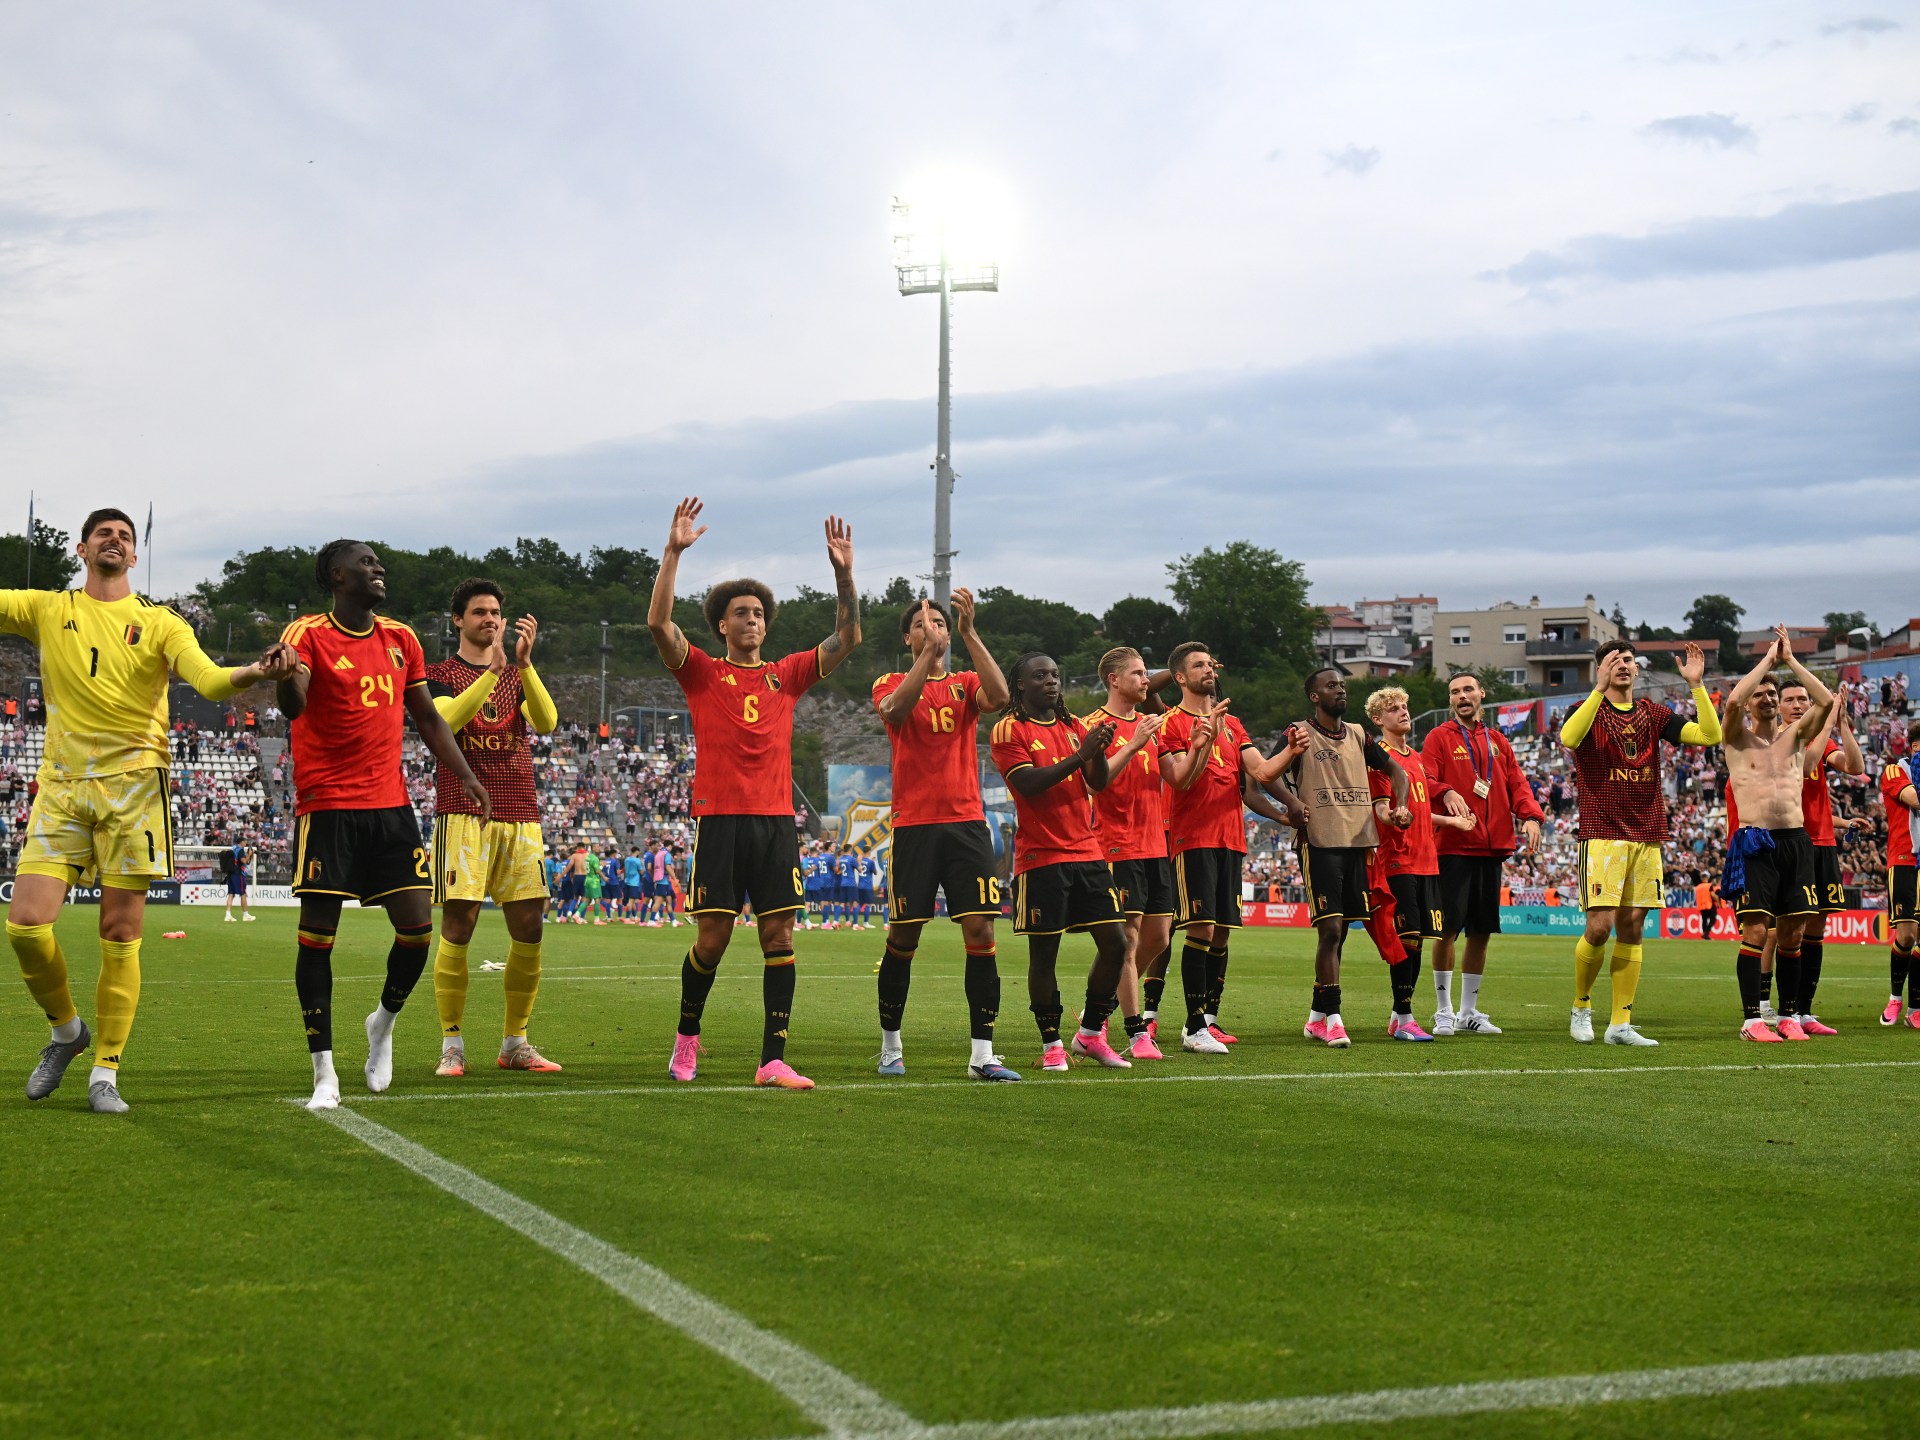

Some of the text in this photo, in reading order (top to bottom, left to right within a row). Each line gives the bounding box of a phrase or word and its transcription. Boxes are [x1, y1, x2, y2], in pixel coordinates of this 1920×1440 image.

[90, 647, 99, 678] 1
[360, 674, 394, 708] 24
[744, 695, 759, 723] 6
[929, 706, 955, 733] 16
[463, 735, 500, 751] ING
[1138, 750, 1150, 775] 7
[1315, 749, 1340, 763] UEFA
[1609, 768, 1640, 782] ING
[1334, 791, 1370, 803] RESPECT
[1411, 781, 1426, 803] 18
[145, 830, 155, 863] 1
[413, 847, 429, 878] 2
[537, 859, 546, 887] 1
[792, 867, 804, 896] 6
[976, 876, 1000, 905] 16
[1655, 878, 1662, 901] 1
[1827, 882, 1846, 904] 20
[251, 889, 299, 900] AIRLINE
[1108, 887, 1120, 913] 1
[1362, 890, 1370, 913] 1
[1803, 884, 1819, 906] 15
[1430, 909, 1443, 931] 18
[1572, 914, 1587, 926] Ud
[1687, 913, 1737, 935] COA
